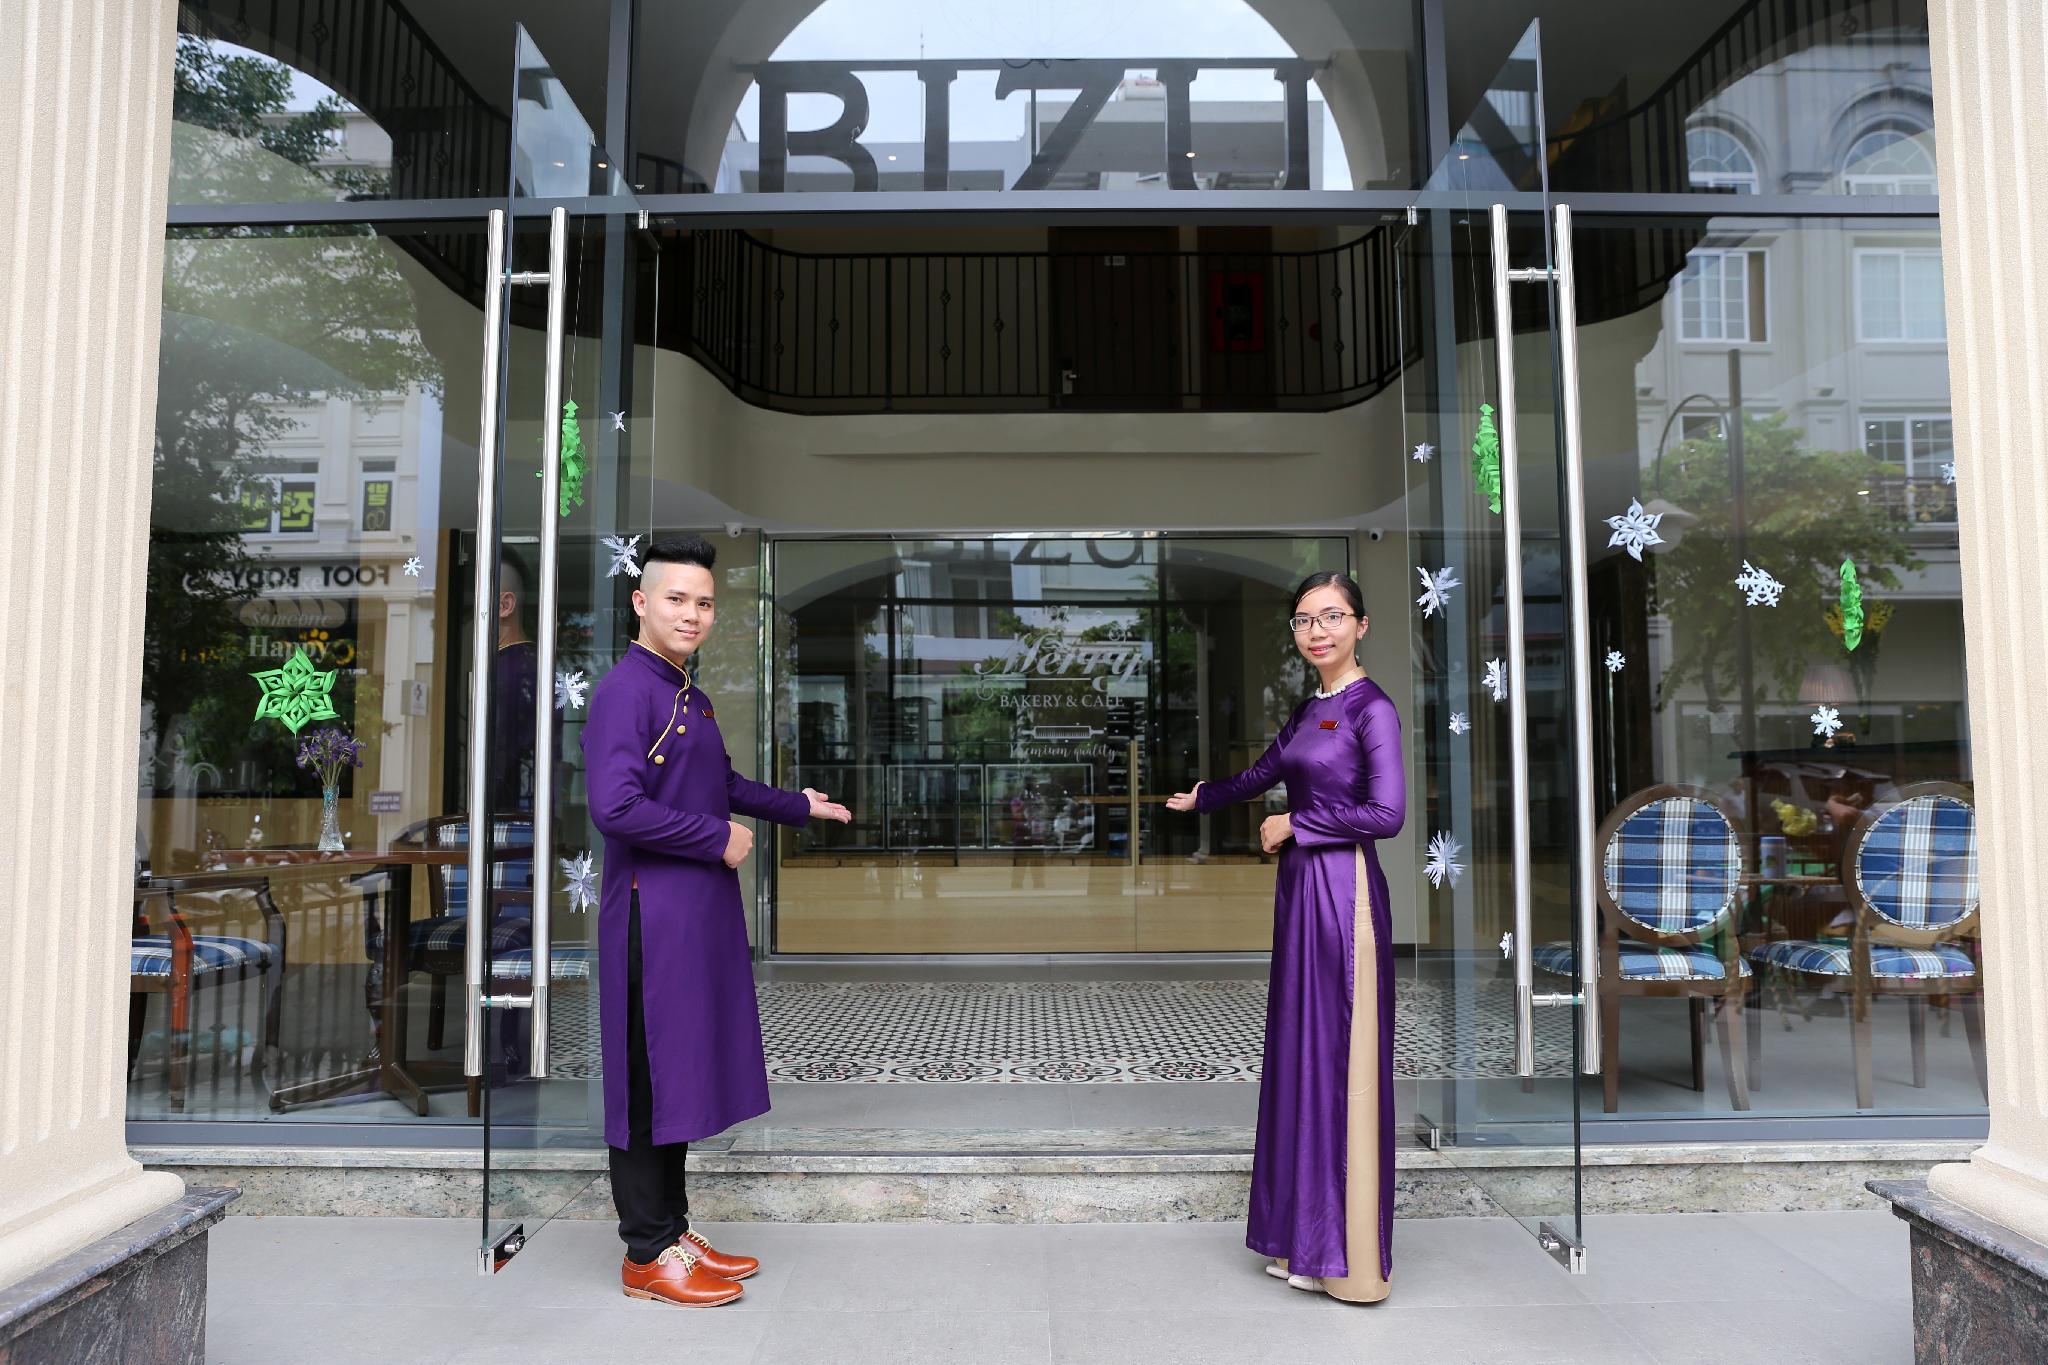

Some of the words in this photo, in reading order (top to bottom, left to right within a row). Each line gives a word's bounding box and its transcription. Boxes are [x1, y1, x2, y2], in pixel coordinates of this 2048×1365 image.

[755, 62, 1313, 191] BIZU
[248, 634, 330, 664] Happy
[974, 631, 1143, 692] Merry
[1000, 694, 1062, 708] BAKERY
[1066, 694, 1078, 708] &
